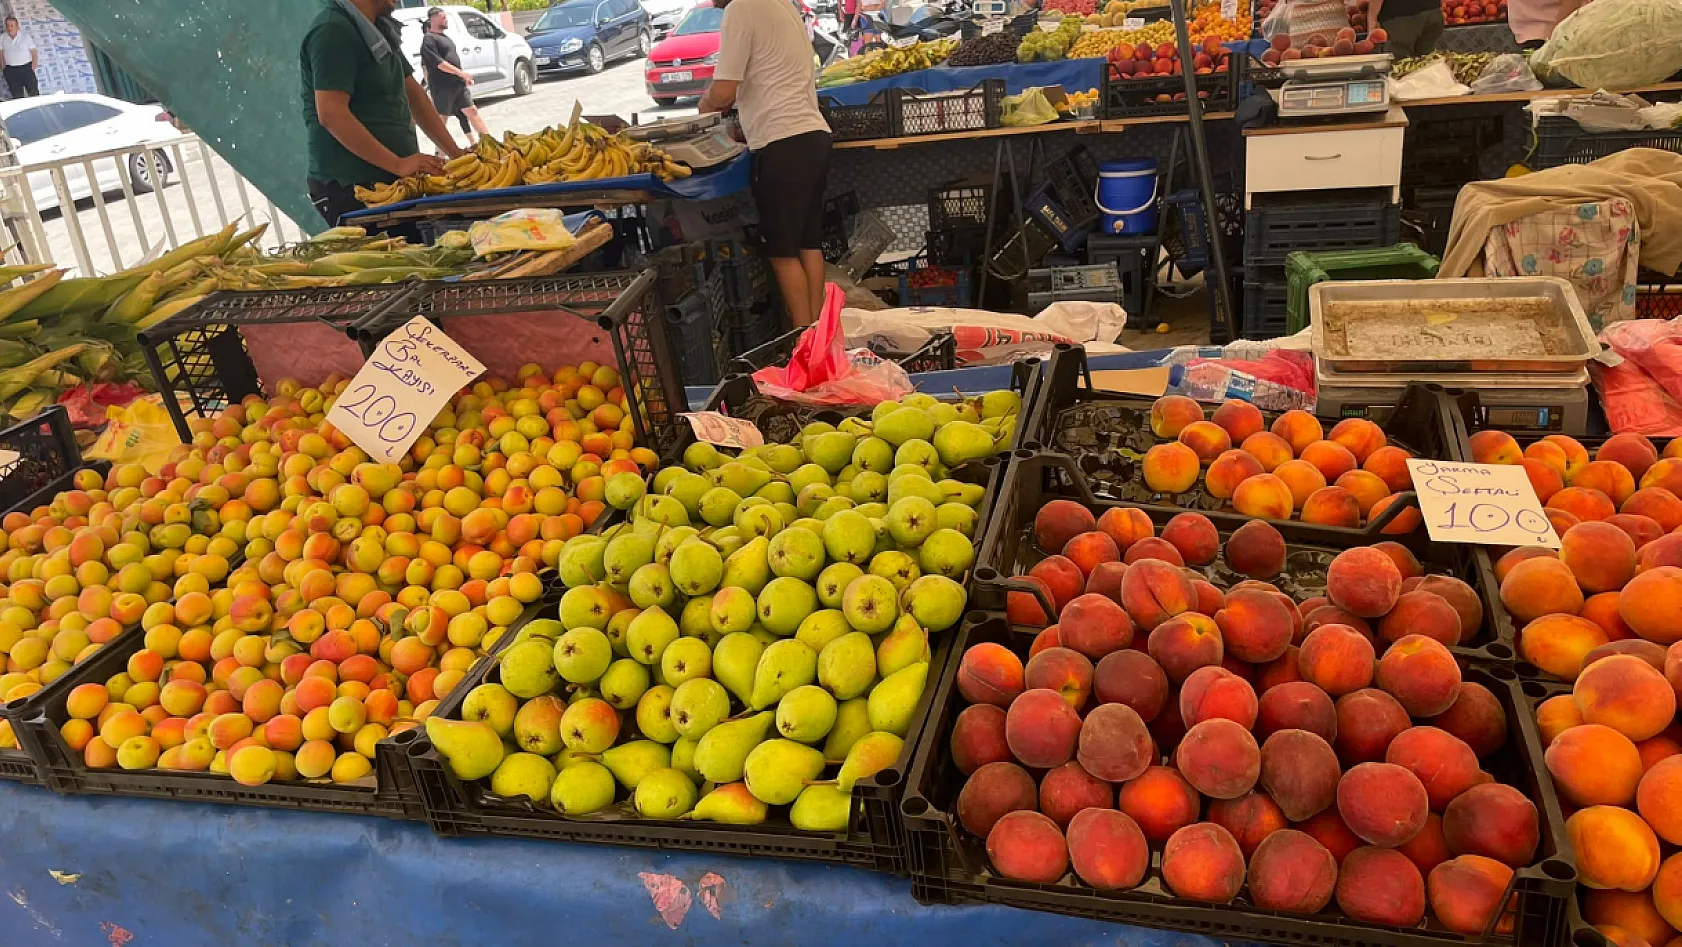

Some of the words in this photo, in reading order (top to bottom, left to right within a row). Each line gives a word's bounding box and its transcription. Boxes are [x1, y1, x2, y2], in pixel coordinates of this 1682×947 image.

[385, 339, 422, 367] BAL
[338, 384, 417, 443] 200
[1437, 502, 1550, 535] 100
